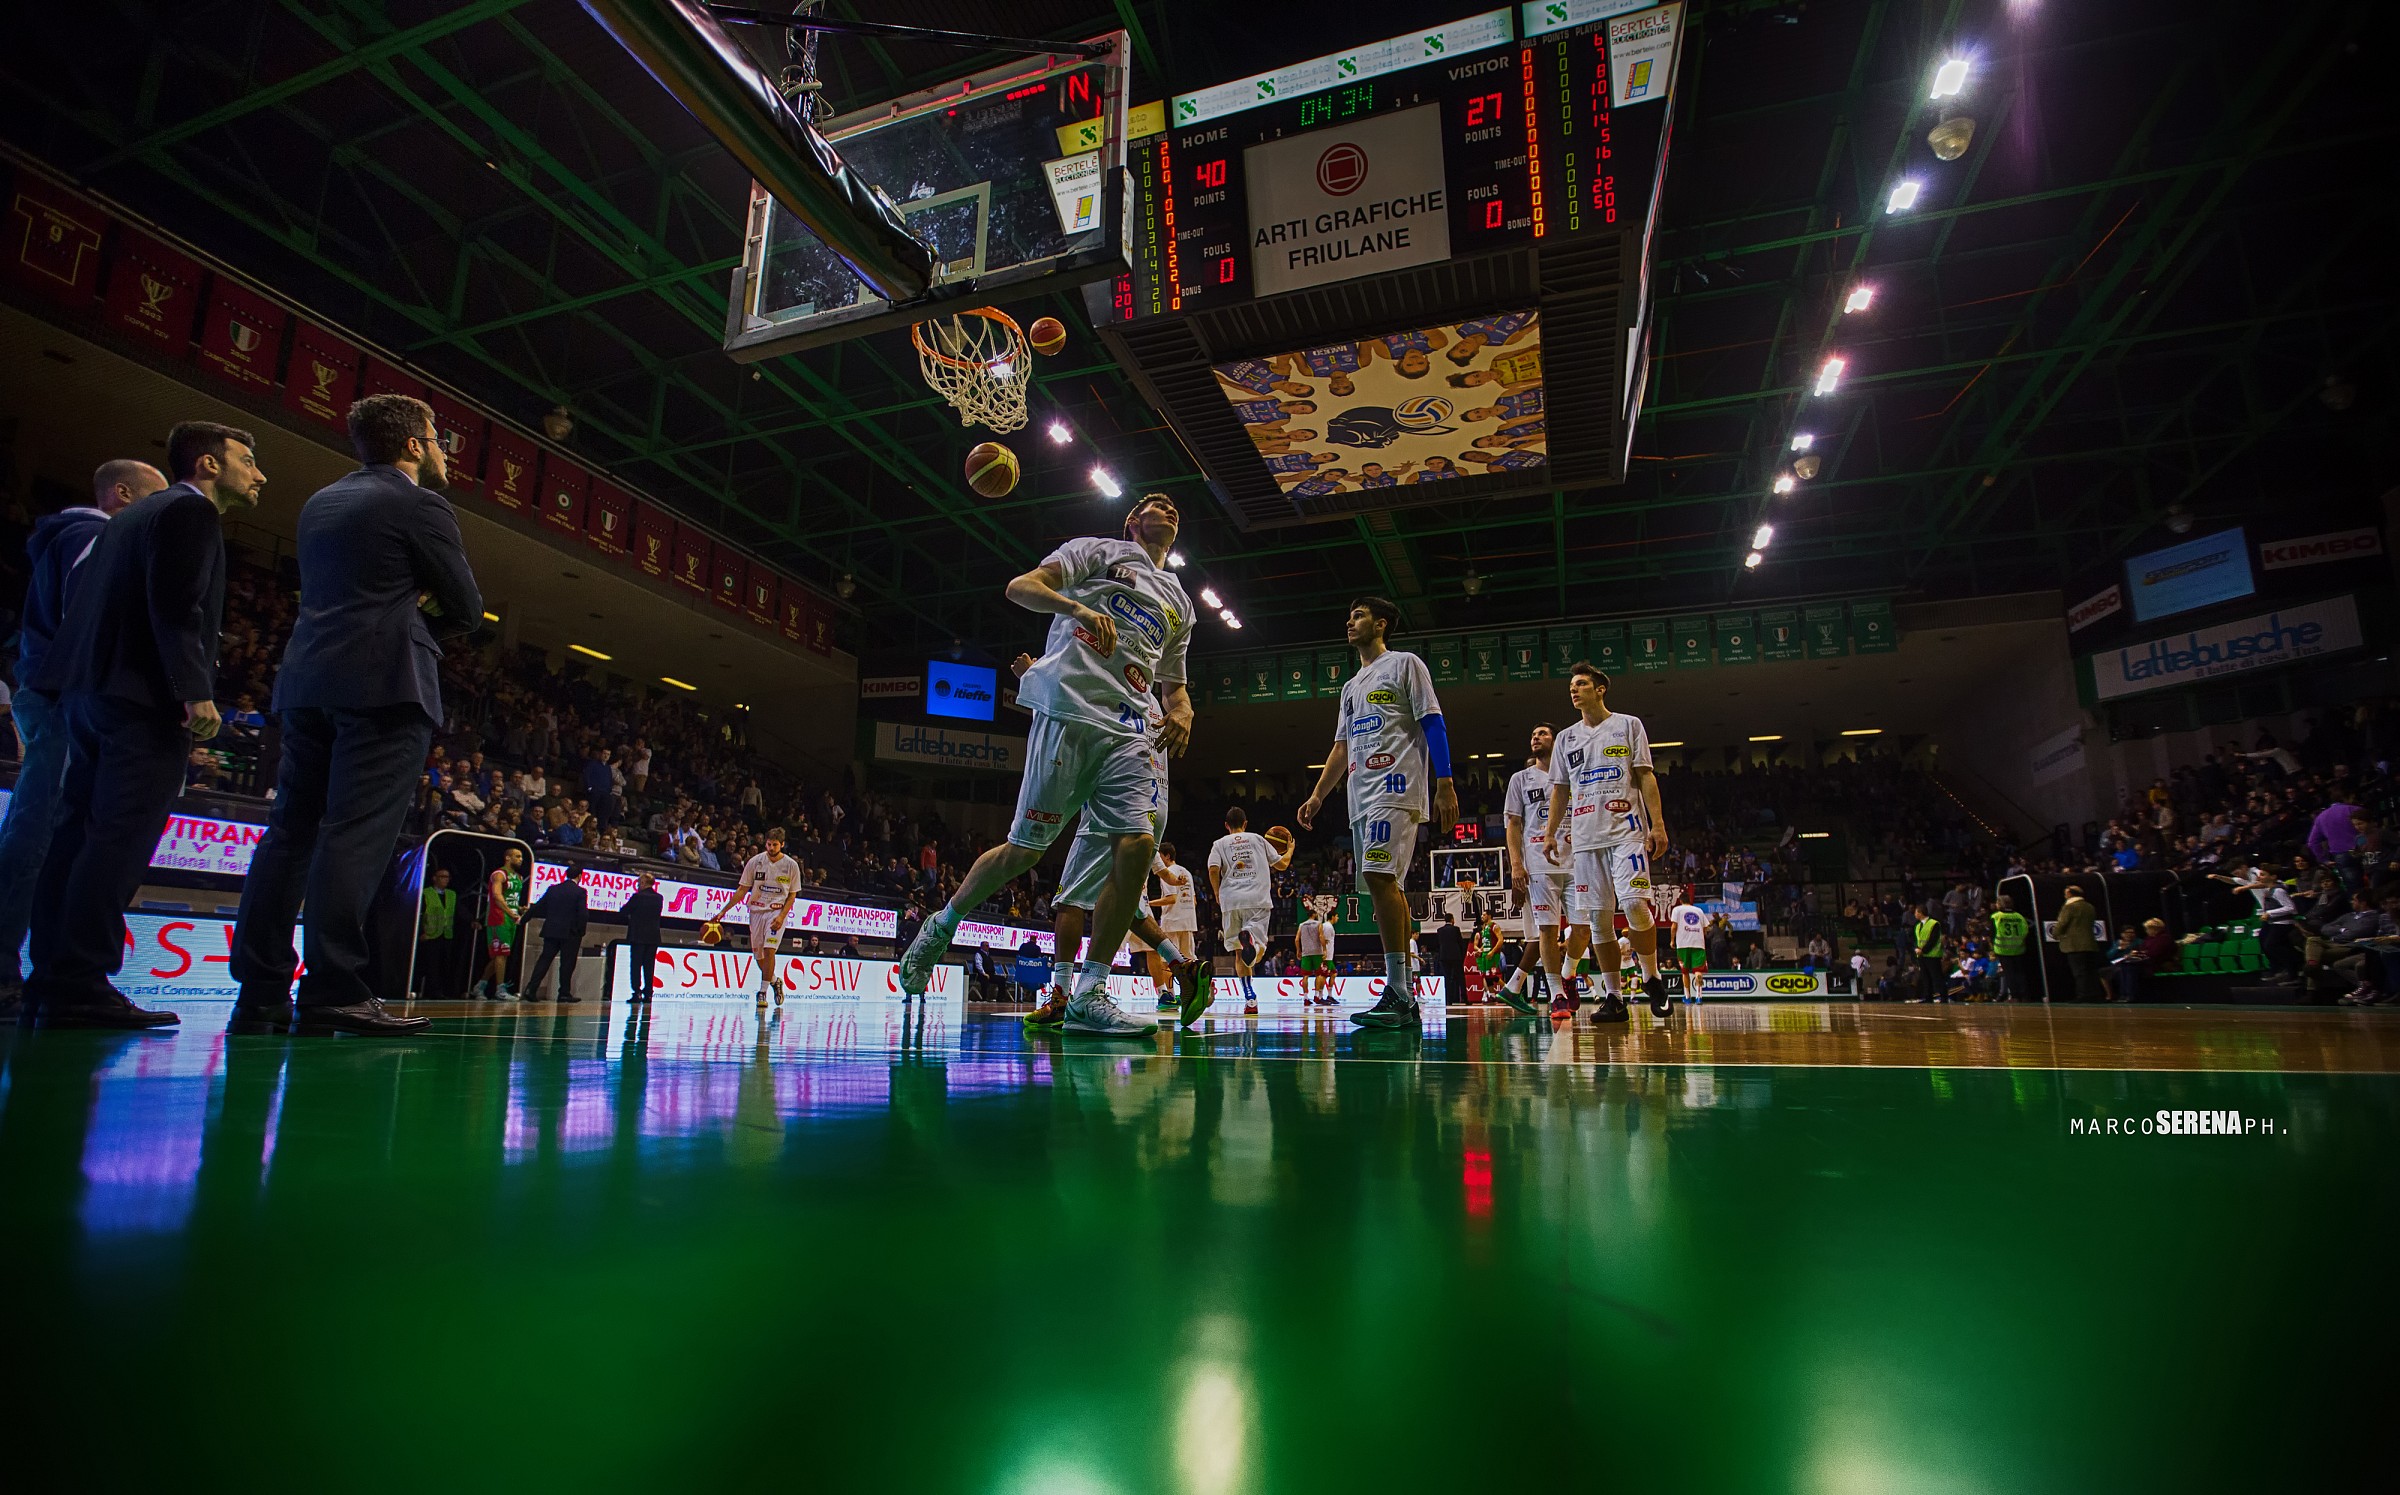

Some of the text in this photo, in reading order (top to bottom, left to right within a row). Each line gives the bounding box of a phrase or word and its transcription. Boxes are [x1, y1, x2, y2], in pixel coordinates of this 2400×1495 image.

[1542, 30, 1570, 45] POINTS
[1448, 56, 1510, 81] VISITOR
[1467, 92, 1503, 127] 27
[1182, 128, 1228, 148] HOME
[1465, 125, 1501, 144] POINTS
[1494, 155, 1527, 170] TIME-OUT
[1196, 159, 1226, 188] 40
[1194, 190, 1226, 207] POINTS
[1467, 184, 1499, 200] FOULS
[1254, 190, 1444, 248] ARTI GRAFICHE
[1486, 200, 1503, 229] 0
[1507, 217, 1531, 230] BONUS
[1177, 227, 1204, 241] TIME-OUT
[1204, 243, 1231, 258] FOULS
[1288, 227, 1411, 270] FRIULANE
[1220, 257, 1235, 284] 0
[1181, 285, 1202, 297] BONUS
[2263, 533, 2379, 565] KIMBO
[2068, 585, 2119, 628] KIMBO
[2121, 613, 2323, 683] lattebusche
[863, 681, 919, 693] KIMBO
[954, 688, 991, 702] itieffe
[1369, 691, 1395, 703] CRICH
[896, 725, 1009, 761] lattebusche
[1364, 741, 1381, 751] BANCA
[1384, 773, 1407, 794] 10
[1625, 813, 1643, 832] 11
[1370, 821, 1391, 843] 10
[1455, 823, 1477, 840] 24
[1366, 851, 1391, 862] CRICH
[1628, 853, 1646, 872] 11
[827, 916, 896, 929] TRIVENETO
[828, 905, 896, 923] SAVITRANSPORT
[958, 920, 1005, 937] SAVITRANSPORT
[2005, 923, 2019, 936] 31
[1770, 978, 1813, 990] CRICH
[686, 992, 723, 1000] Communication
[724, 993, 750, 1001] Technology
